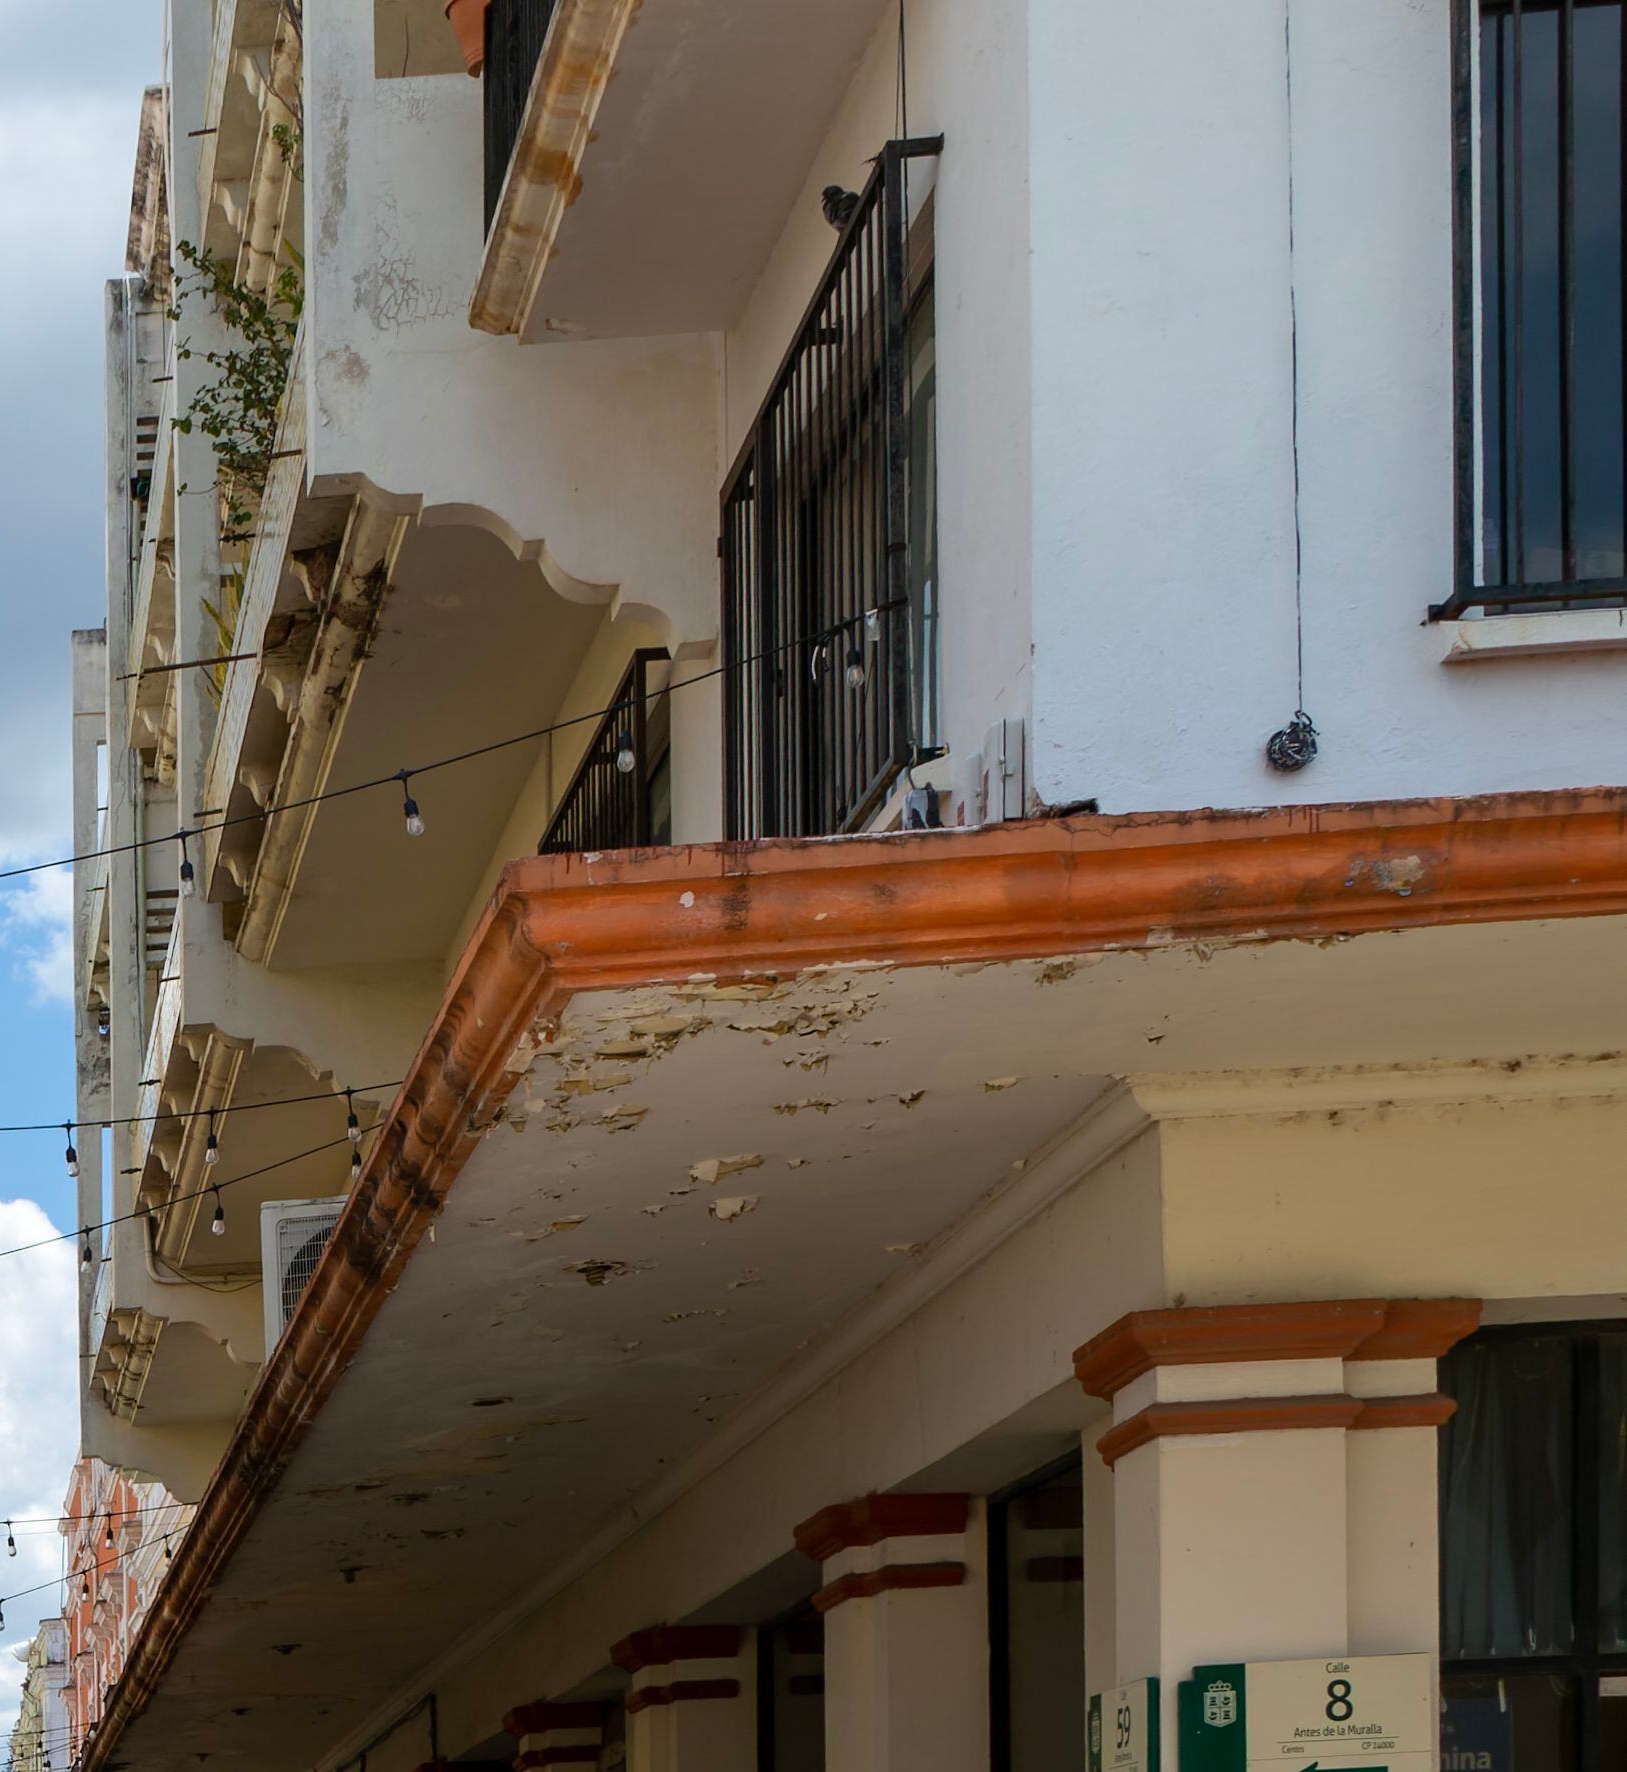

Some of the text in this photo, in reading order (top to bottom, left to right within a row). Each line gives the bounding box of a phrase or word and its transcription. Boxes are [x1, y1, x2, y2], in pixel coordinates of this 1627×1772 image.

[1326, 1662, 1350, 1674] Calle
[1326, 1679, 1353, 1722] 8
[1116, 1705, 1131, 1750] 59
[1294, 1723, 1383, 1738] Antes de la Muralla
